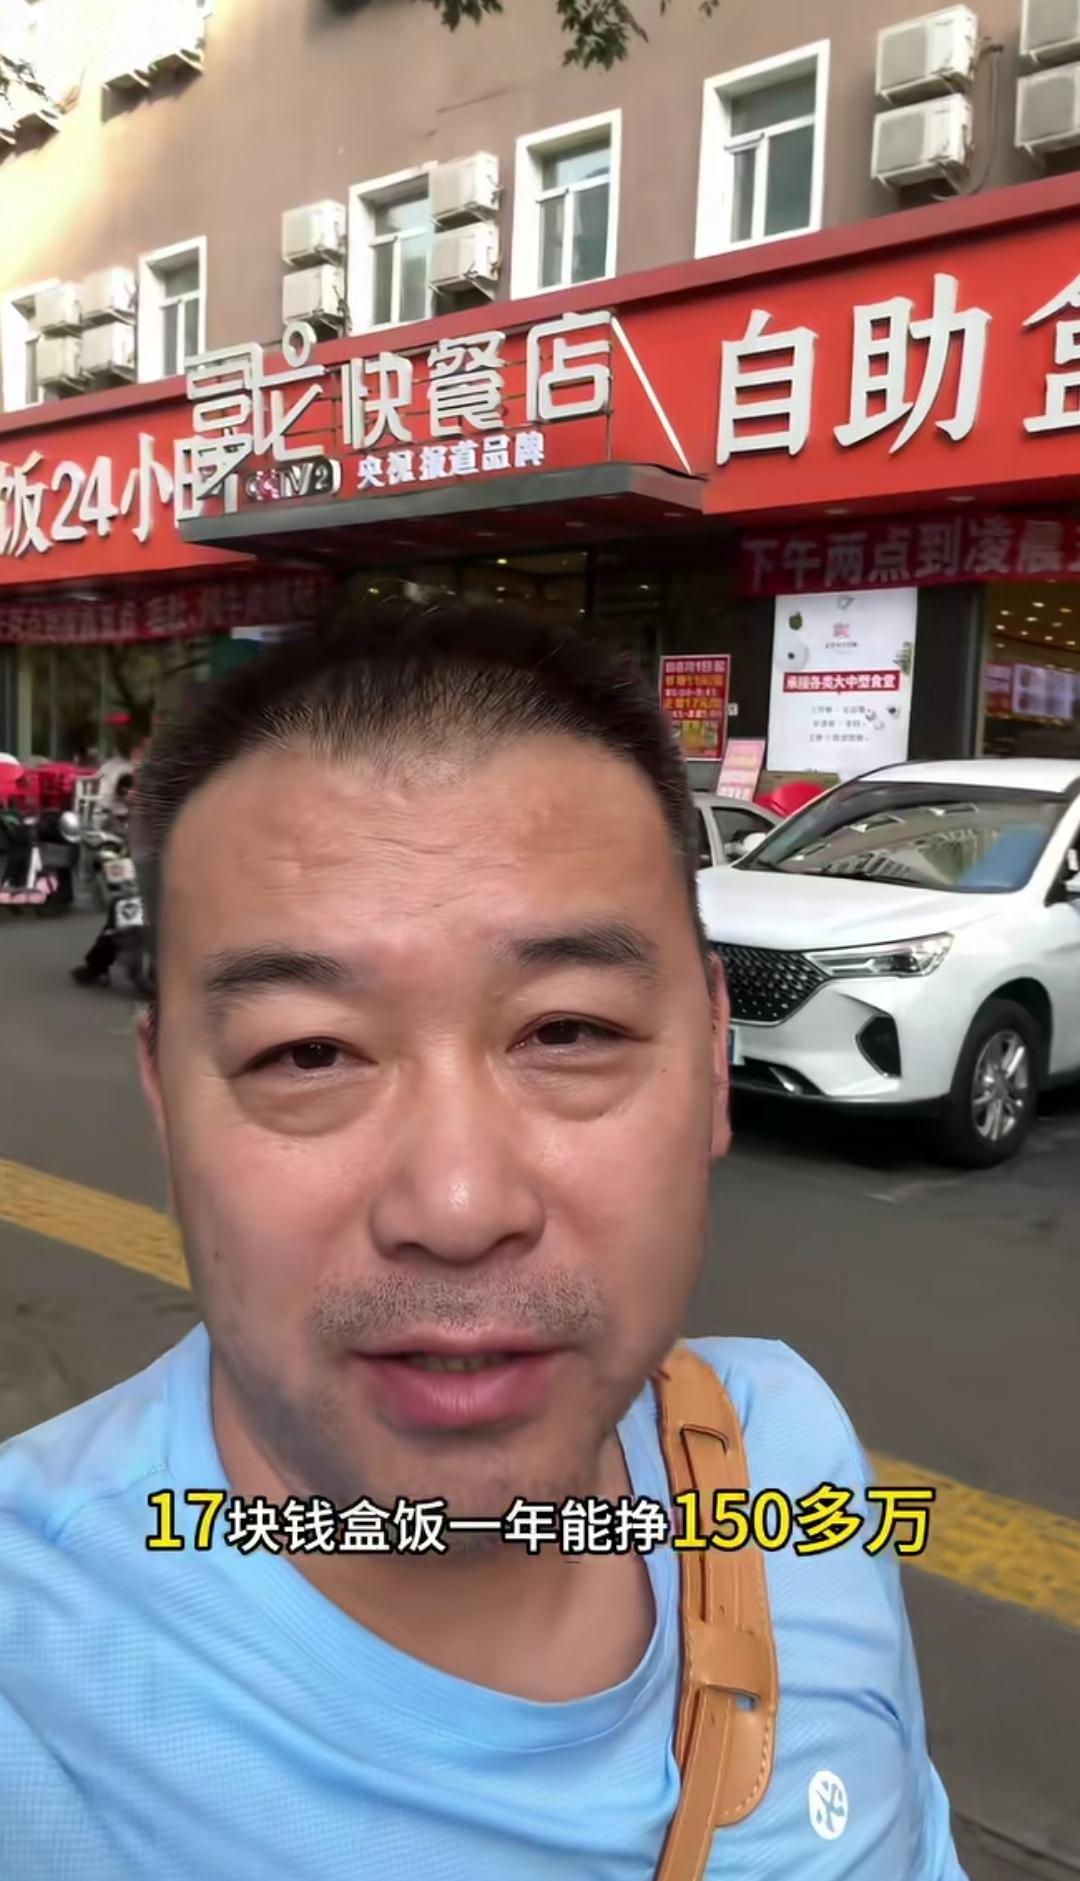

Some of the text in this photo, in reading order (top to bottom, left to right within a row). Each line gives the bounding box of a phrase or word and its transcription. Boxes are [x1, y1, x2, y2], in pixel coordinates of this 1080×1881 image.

[742, 514, 1080, 592] 下午两点到凌晨
